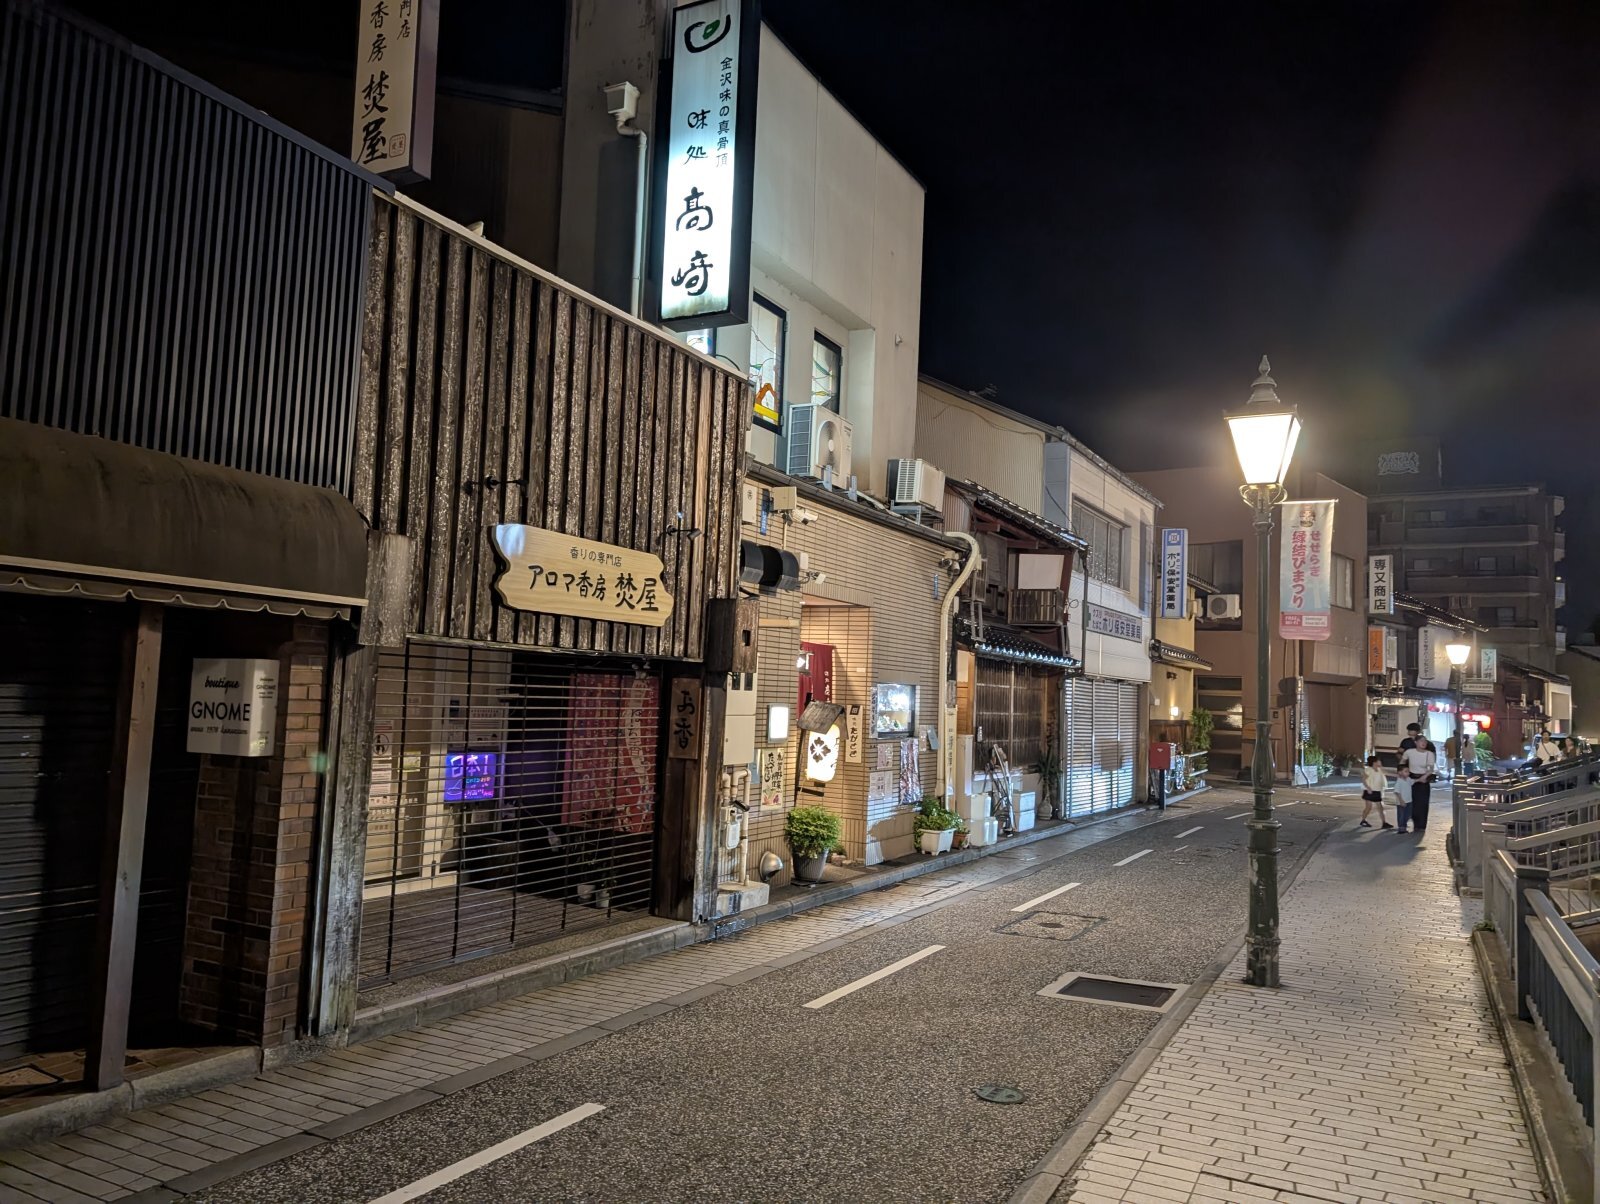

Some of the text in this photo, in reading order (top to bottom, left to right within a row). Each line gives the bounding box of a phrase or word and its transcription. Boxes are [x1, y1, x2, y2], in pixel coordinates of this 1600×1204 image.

[716, 57, 733, 168] 金沢味の真骨頂
[570, 546, 622, 567] 香りの専門店
[204, 676, 240, 695] boutique
[191, 701, 251, 721] GNOME
[674, 690, 696, 749] お香
